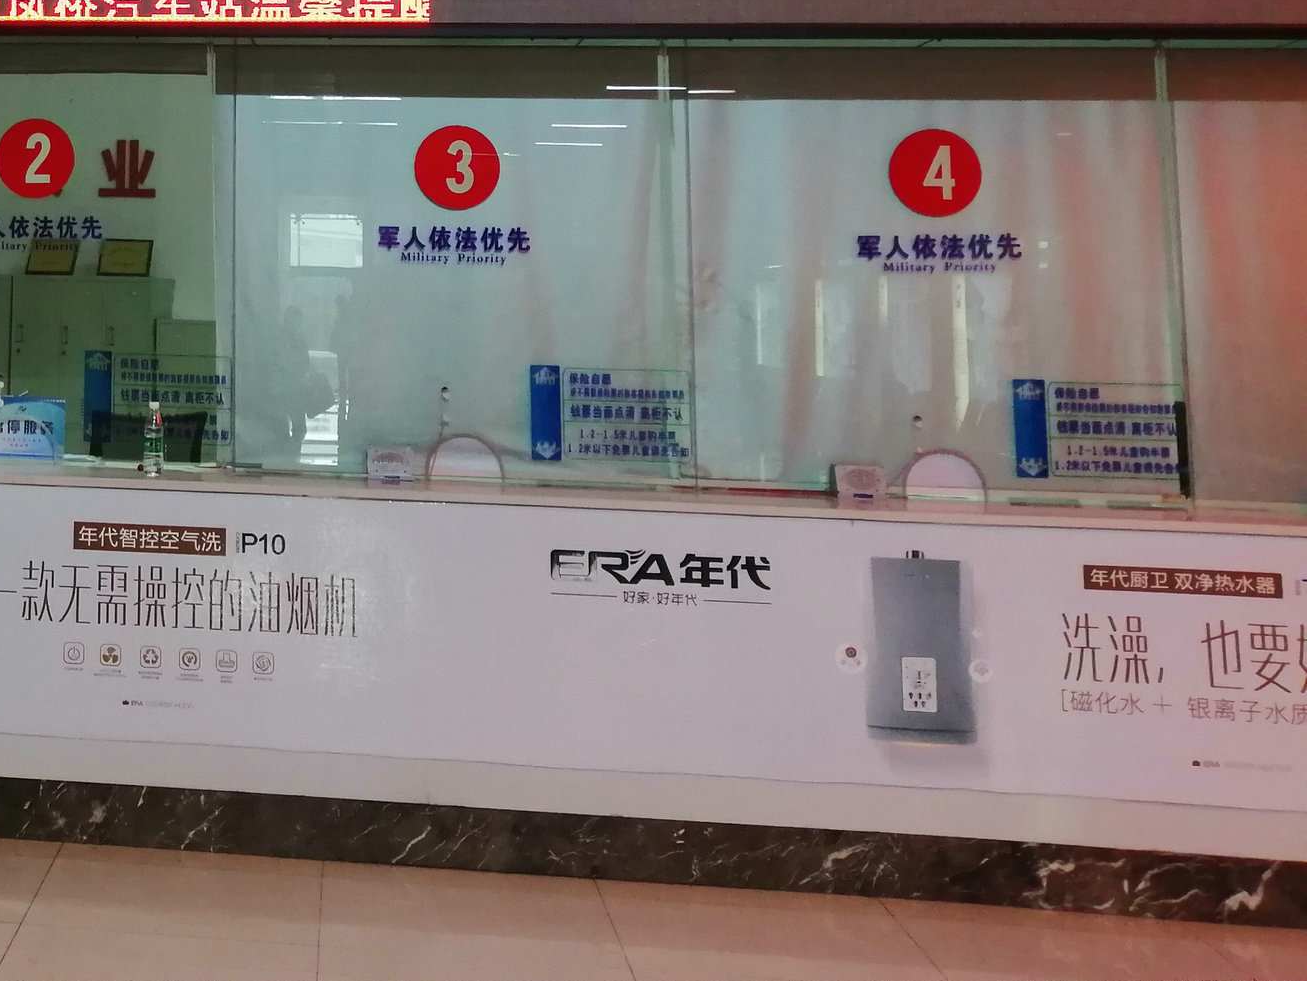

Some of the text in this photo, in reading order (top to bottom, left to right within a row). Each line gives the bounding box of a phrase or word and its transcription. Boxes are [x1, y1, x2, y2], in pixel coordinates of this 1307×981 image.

[25, 132, 51, 184] 2
[446, 140, 474, 194] 3
[923, 145, 956, 200] 4
[35, 242, 80, 254] Priority
[378, 226, 531, 253] 军人依法优先
[857, 233, 1022, 261] 军人依法优先
[401, 252, 507, 266] Military Priority
[882, 261, 997, 274] Military Priority
[569, 373, 611, 385] 保险自愿
[78, 525, 222, 552] 年代智控空气洗
[241, 532, 286, 555] P10
[1090, 569, 1169, 590] 年代厨卫
[1174, 572, 1276, 595] 双净热水器
